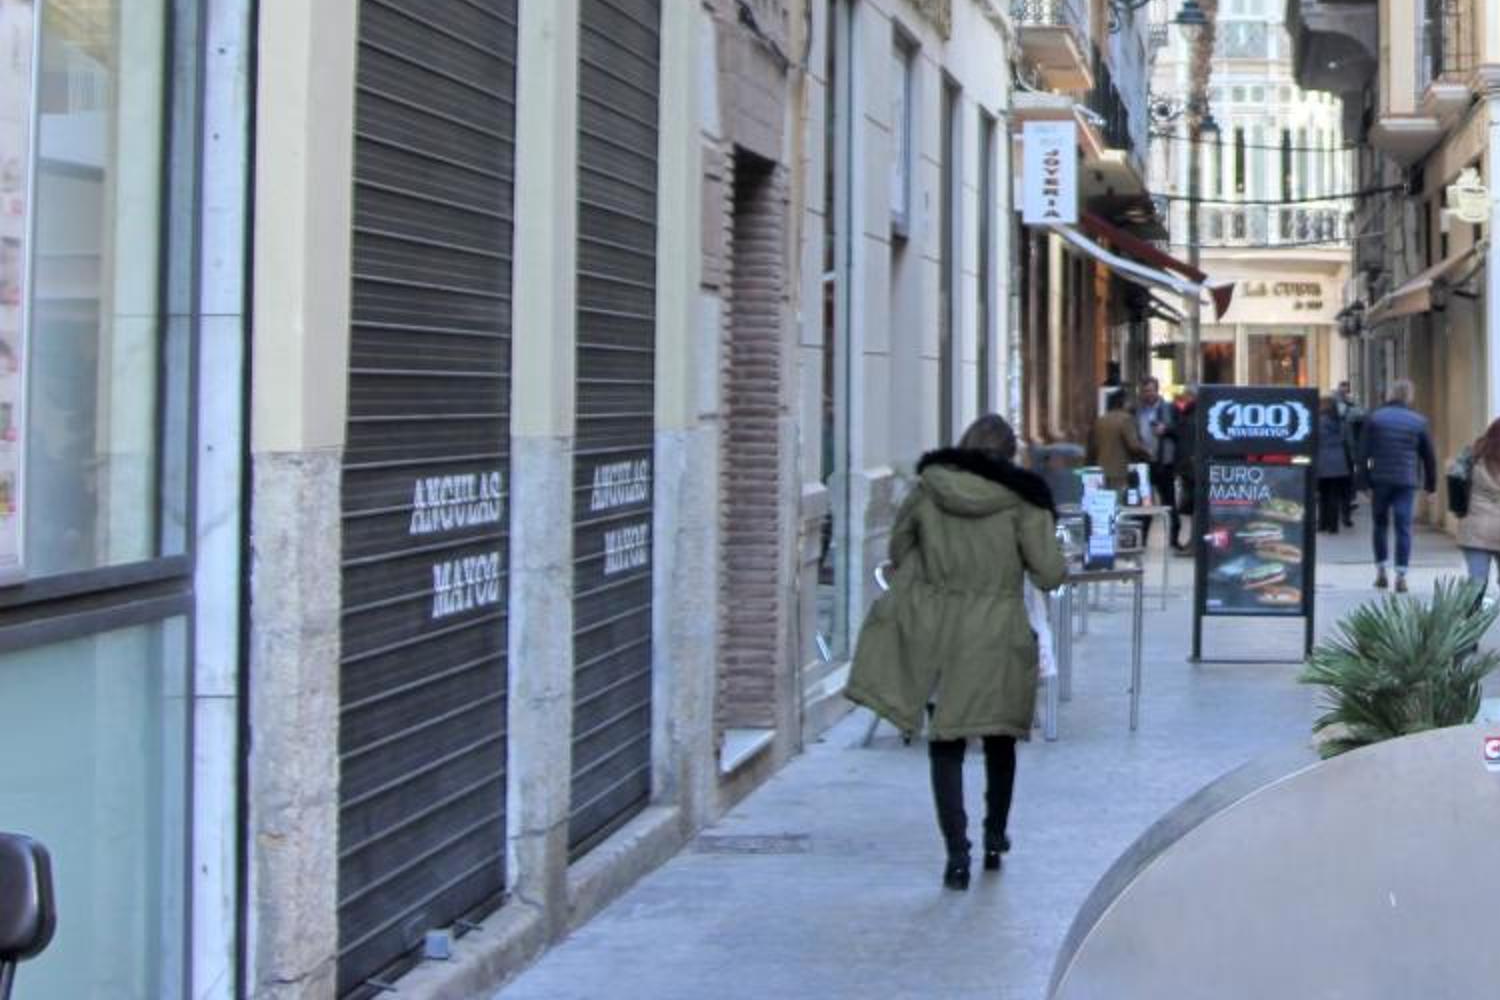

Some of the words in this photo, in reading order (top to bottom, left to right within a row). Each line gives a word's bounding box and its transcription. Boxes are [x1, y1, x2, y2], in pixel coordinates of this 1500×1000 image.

[1226, 404, 1290, 427] 100
[591, 458, 648, 512] ANGULAS
[1209, 465, 1264, 484] EURO
[1209, 484, 1272, 503] MANIA
[409, 471, 501, 535] ANGULAS
[432, 552, 500, 619] MAYOZ
